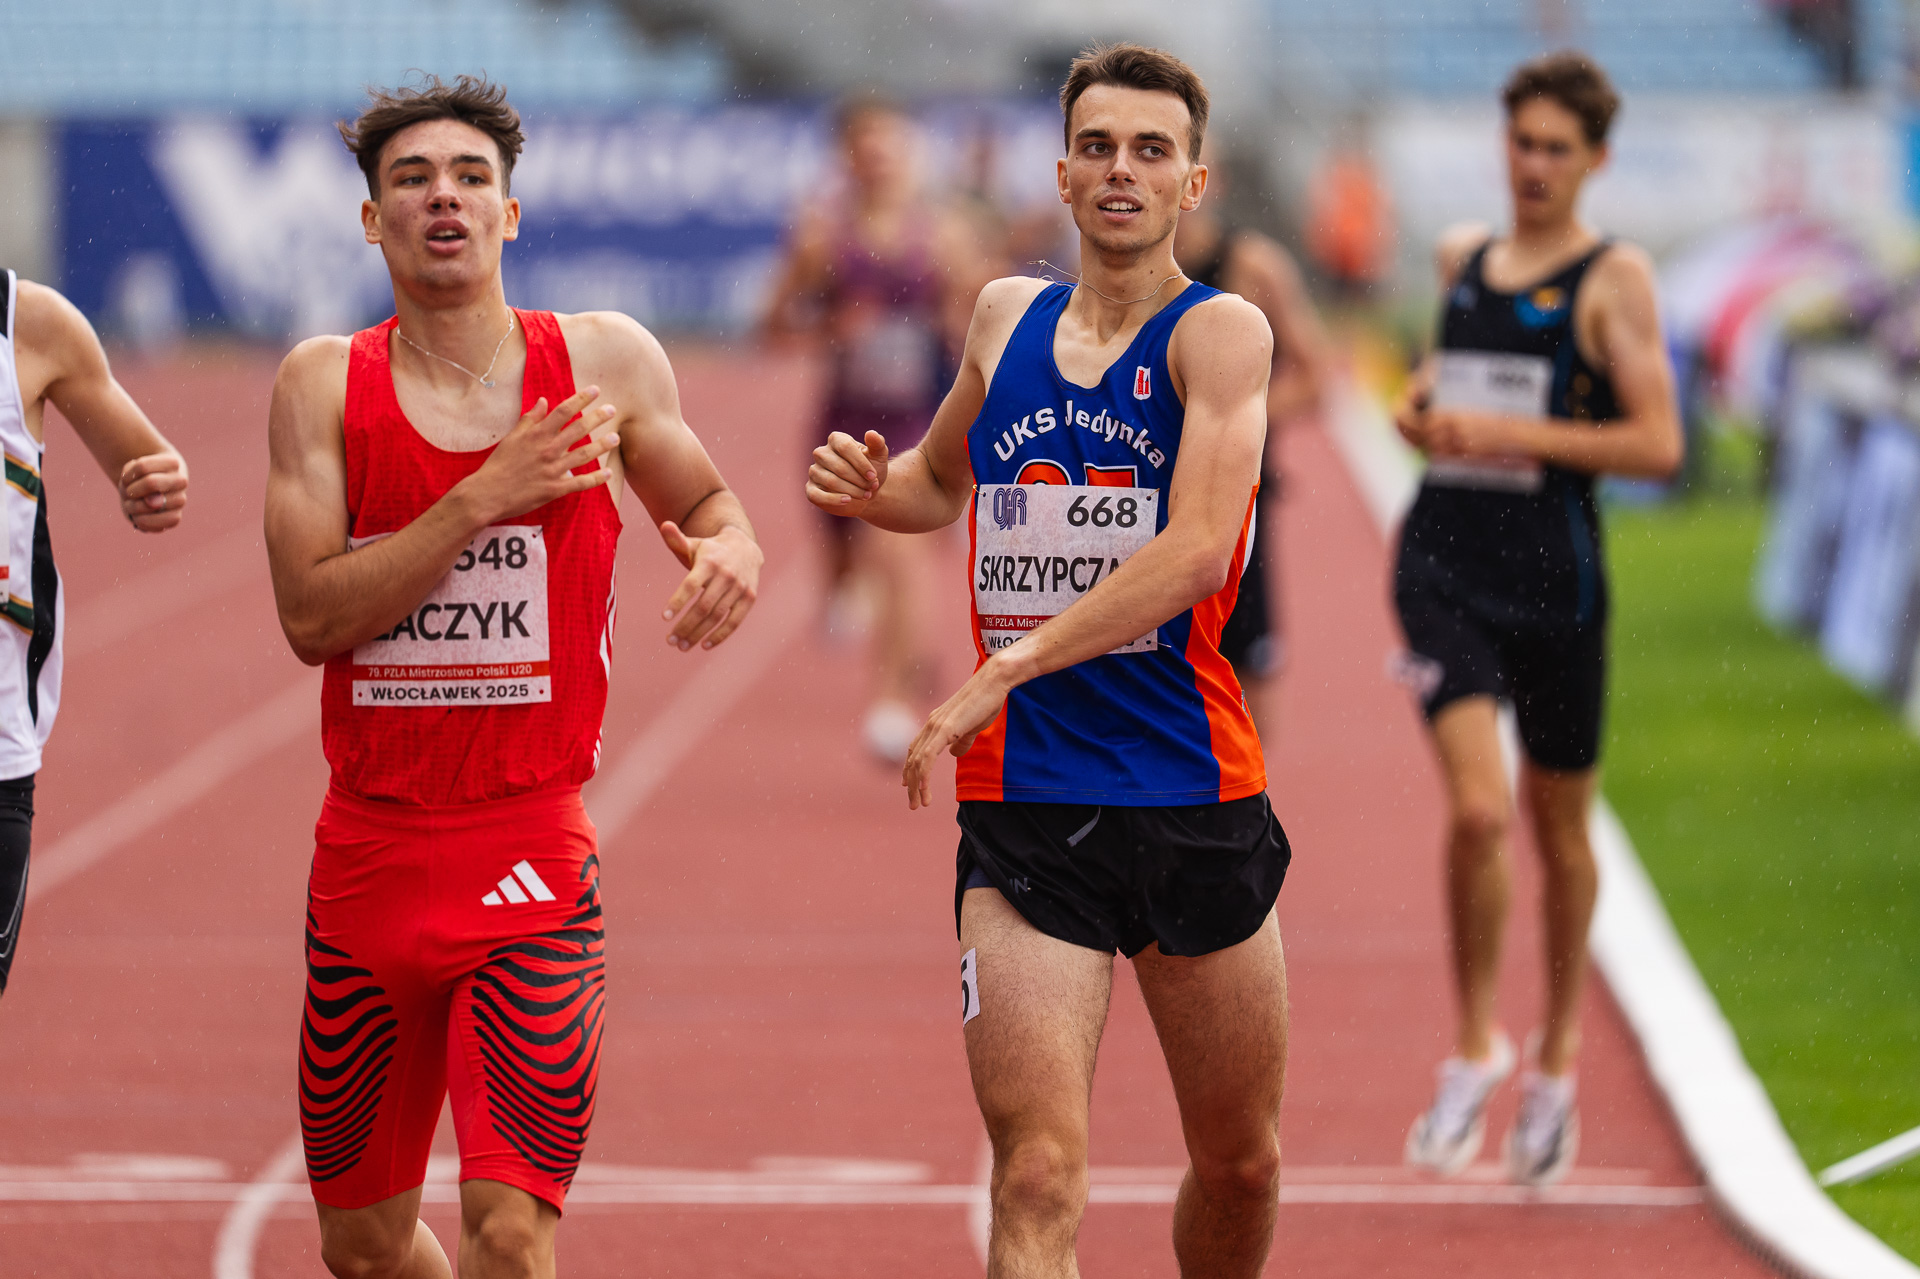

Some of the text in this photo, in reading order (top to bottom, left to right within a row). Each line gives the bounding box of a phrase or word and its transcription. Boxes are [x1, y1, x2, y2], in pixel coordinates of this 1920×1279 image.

[993, 400, 1166, 469] UKS Jedynka
[1067, 495, 1138, 528] 668
[979, 555, 1119, 593] SKRZYPCZ
[372, 600, 531, 641] ACZYK
[995, 617, 1015, 628] PZLA
[1016, 617, 1048, 628] Mistr
[368, 664, 533, 678] 79. PZLA Mistrzostwa Polski U20
[371, 683, 529, 701] WŁOCŁAWEK 2025
